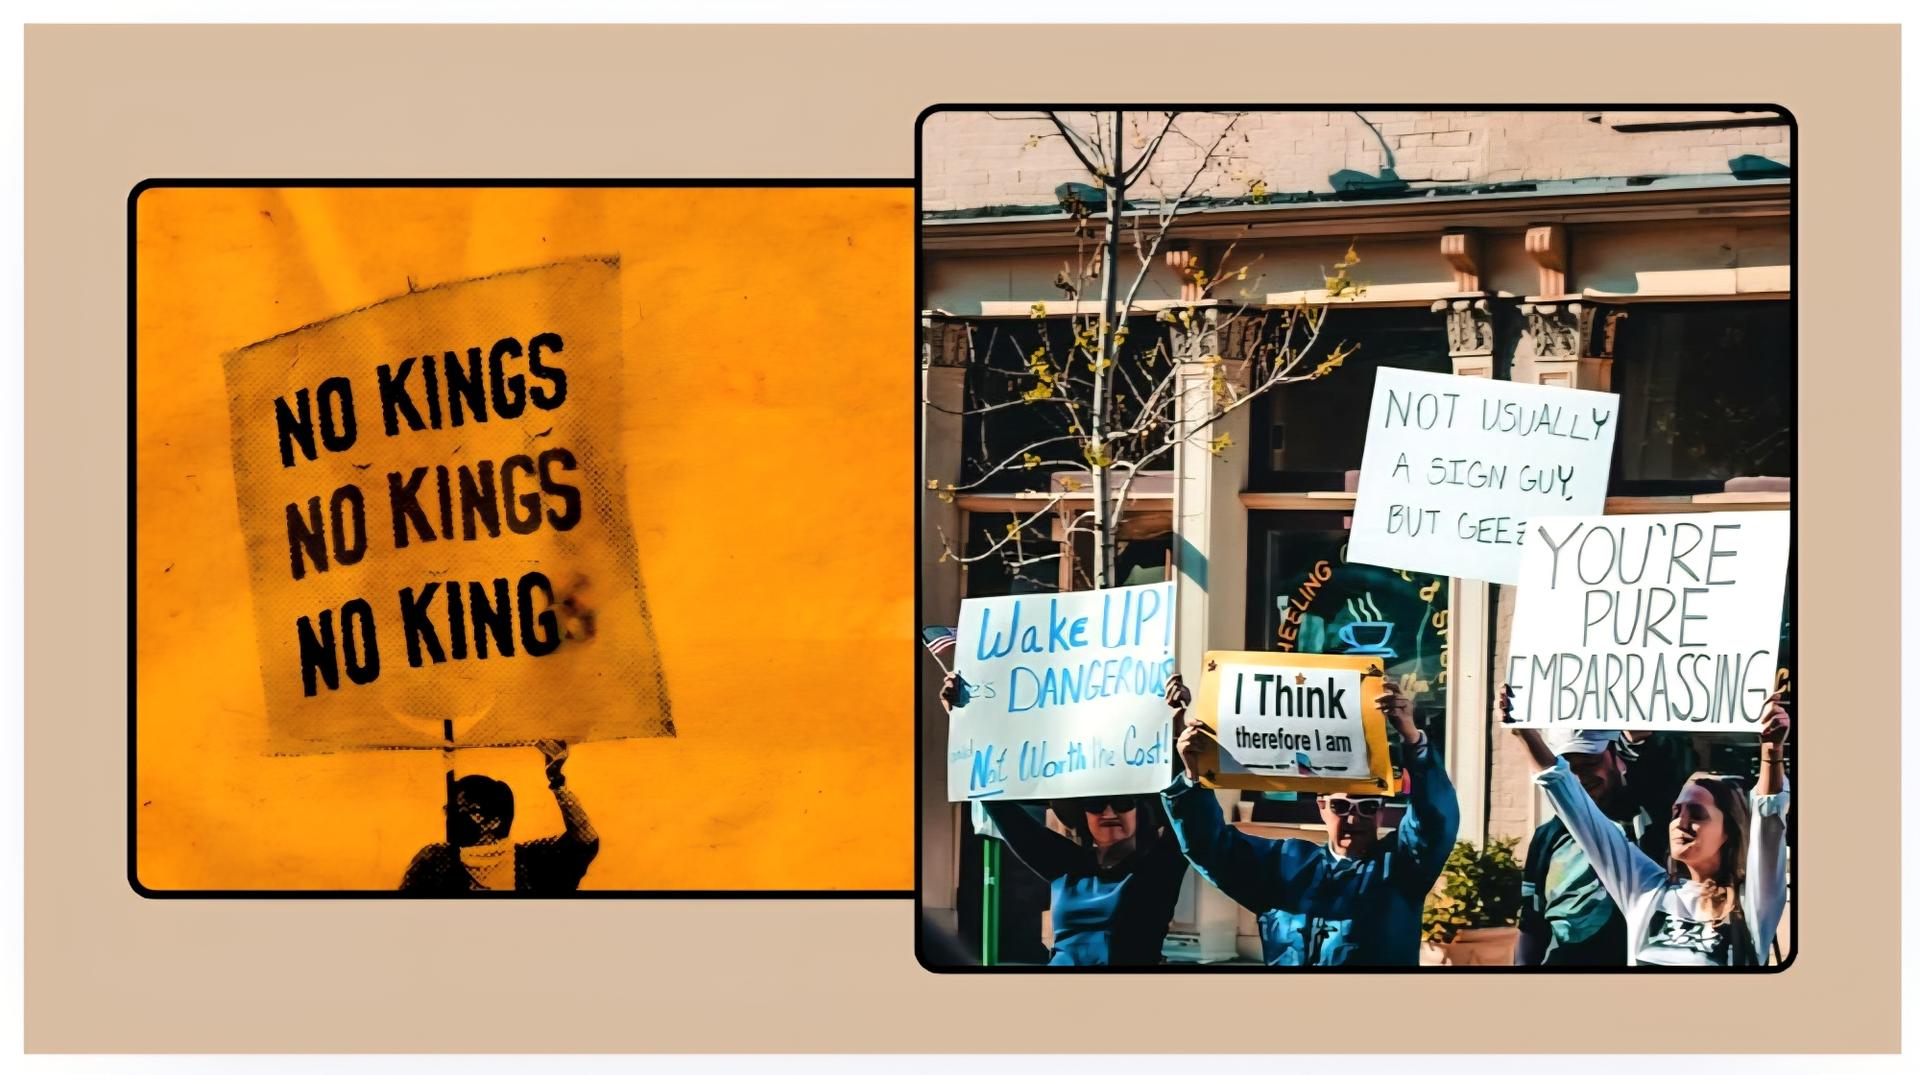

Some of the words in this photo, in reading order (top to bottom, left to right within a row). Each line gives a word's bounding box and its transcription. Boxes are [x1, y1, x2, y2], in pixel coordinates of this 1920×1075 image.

[274, 376, 358, 468] NO
[377, 332, 568, 437] KINGS
[1385, 389, 1460, 430] NOT
[1482, 398, 1610, 440] USUALLY
[1392, 452, 1410, 483] A
[1427, 457, 1507, 490] SIGN
[285, 484, 368, 581] NO
[387, 447, 582, 549] KINGS
[1387, 504, 1440, 538] BUT
[1538, 522, 1741, 589] YOU'RE
[296, 598, 380, 697] NO
[977, 599, 1089, 660] Wake
[1102, 585, 1176, 655] UP!
[1582, 587, 1709, 648] PURE
[1234, 673, 1243, 714] I
[1254, 673, 1347, 719] Think
[1508, 650, 1770, 723] EMBARRASSING
[1018, 740, 1086, 781] Worth
[1123, 724, 1169, 766] Cost!
[1235, 726, 1311, 751] therefore
[1315, 729, 1321, 751] I
[1326, 735, 1352, 752] am
